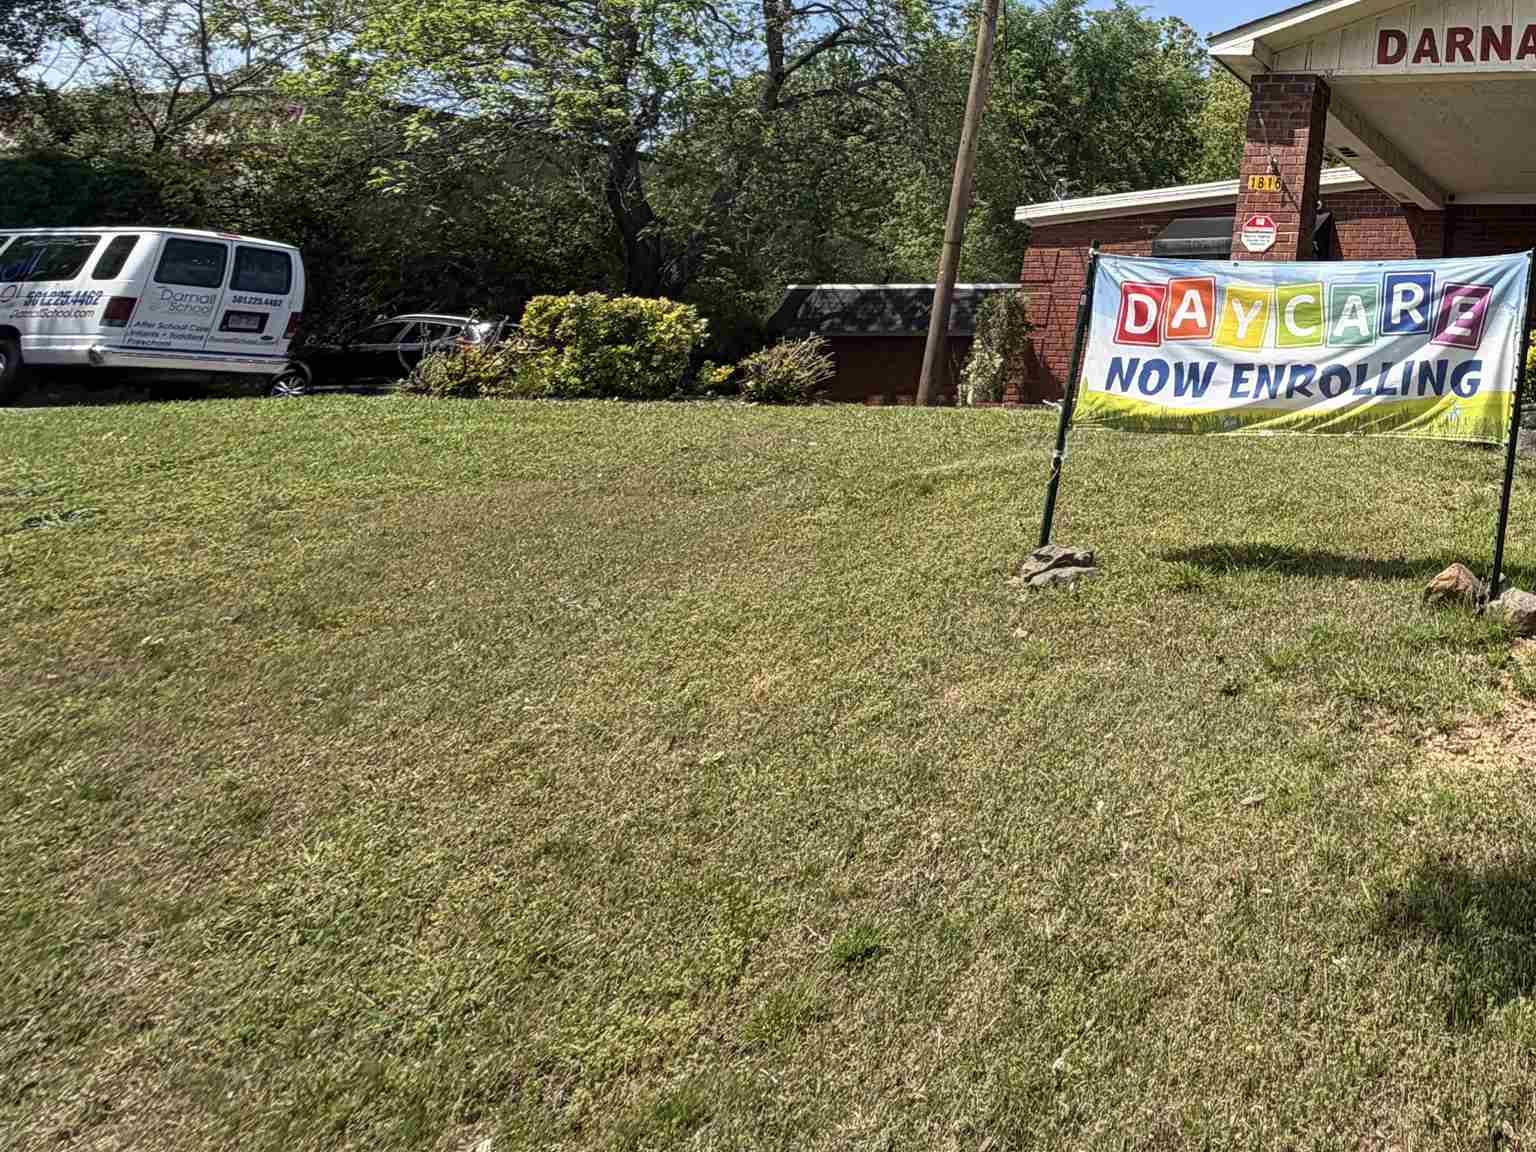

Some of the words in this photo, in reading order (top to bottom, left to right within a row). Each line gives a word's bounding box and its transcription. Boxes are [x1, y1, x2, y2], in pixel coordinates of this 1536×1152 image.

[1251, 176, 1281, 190] 1816
[168, 301, 213, 316] School
[1125, 281, 1484, 338] DAYCARE
[1105, 356, 1218, 399] NOW
[1229, 358, 1484, 400] ENROLLING
